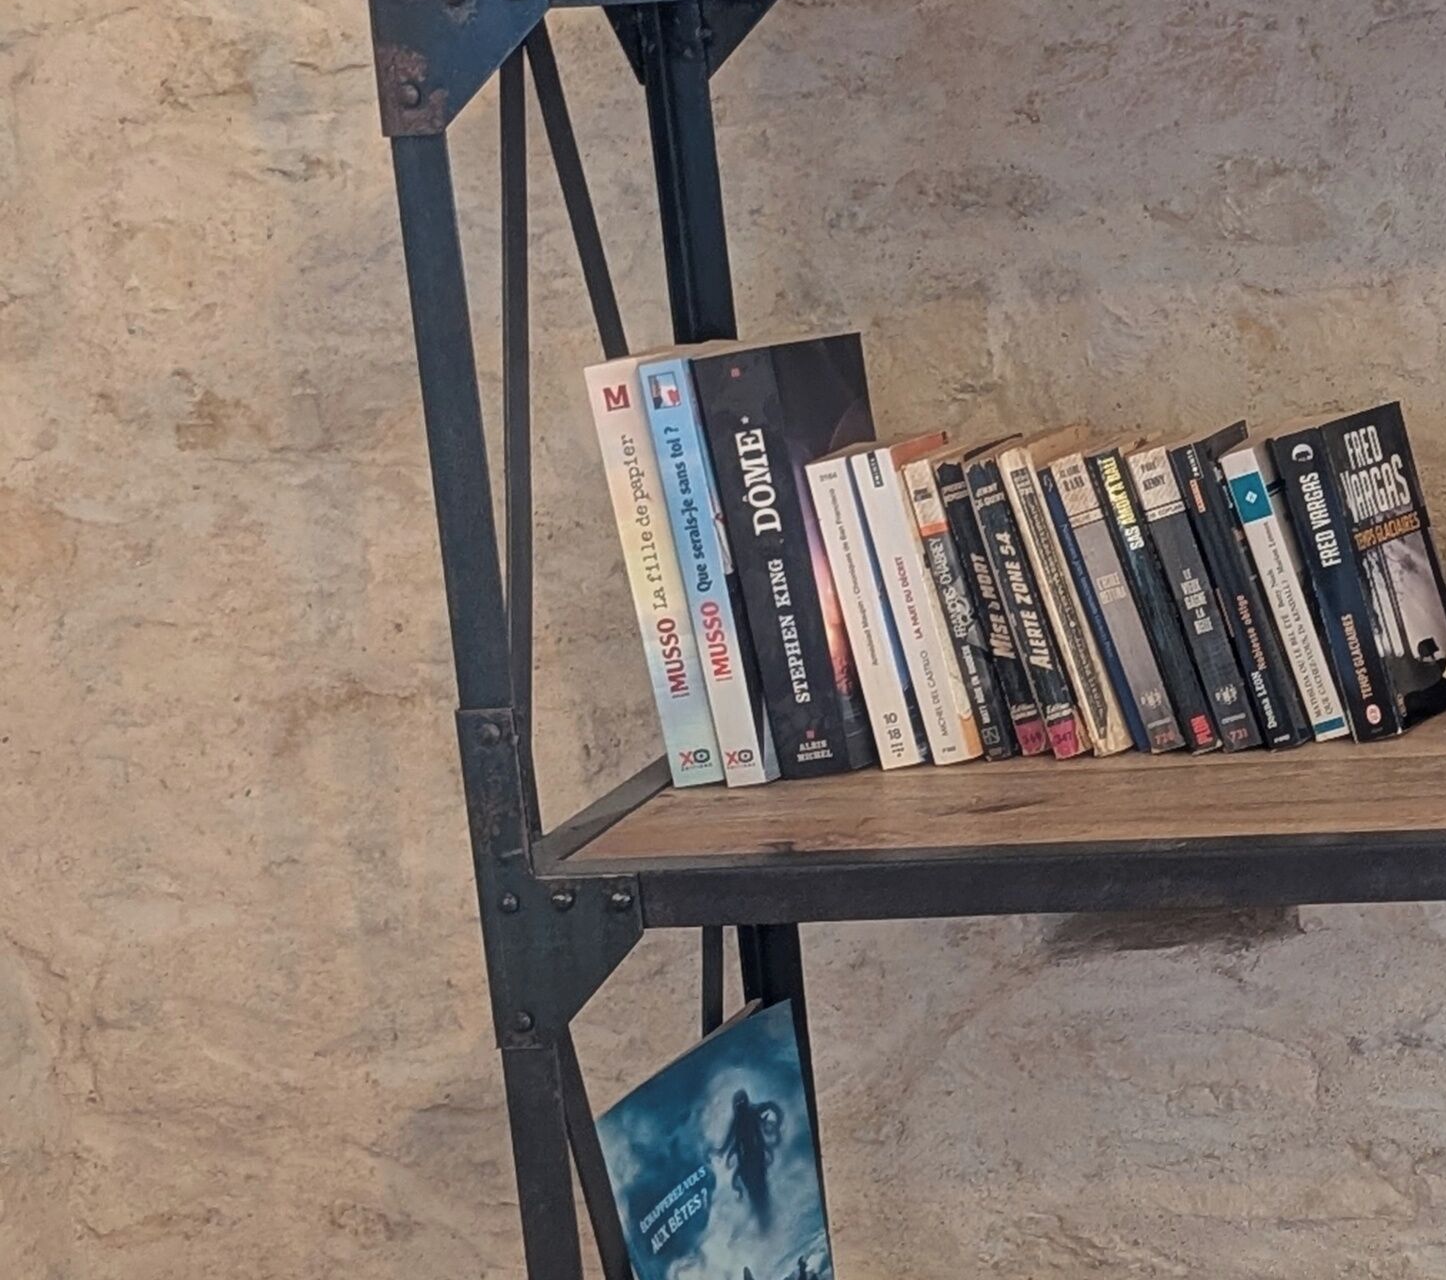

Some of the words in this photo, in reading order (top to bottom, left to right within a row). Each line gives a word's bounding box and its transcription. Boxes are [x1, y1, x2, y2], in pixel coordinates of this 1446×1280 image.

[667, 438, 684, 458] toi
[1344, 425, 1383, 470] FRED
[621, 434, 651, 503] papier
[674, 462, 692, 495] sans
[1097, 456, 1121, 482] BALI
[1299, 471, 1330, 529] VARGAS
[1340, 453, 1411, 523] VARGAS
[636, 508, 651, 526] de
[1109, 492, 1136, 525] AMOK
[681, 498, 704, 559] serais-je
[1124, 525, 1145, 550] SAS
[640, 531, 662, 582] fille
[1313, 528, 1342, 568] FRED
[696, 563, 713, 592] Que
[767, 559, 791, 606] KING
[892, 555, 910, 588] DÉCRET
[970, 552, 993, 601] MORT
[1004, 562, 1033, 607] ZONE
[653, 588, 668, 610] La
[903, 588, 913, 602] DU
[1237, 593, 1252, 625] oblige
[906, 603, 920, 626] NUIT
[700, 601, 733, 677] MUSSO
[913, 627, 923, 639] LA
[1021, 608, 1053, 671] ALERTE
[1246, 626, 1267, 671] Noblesse
[1341, 614, 1365, 667] GLACIAIRES
[657, 618, 689, 693] MUSSO
[778, 614, 811, 704] STEPHEN
[918, 649, 937, 688] CASTILLO
[929, 689, 941, 704] DEL
[1251, 671, 1266, 696] LEON
[1356, 666, 1373, 699] TEMPS
[883, 712, 898, 724] 10
[933, 705, 950, 736] MICHEL
[1260, 696, 1277, 729] Donna
[1320, 695, 1333, 715] QUE
[887, 728, 902, 740] 18
[651, 1224, 670, 1254] AUX
[668, 1194, 702, 1234] BÊTES
